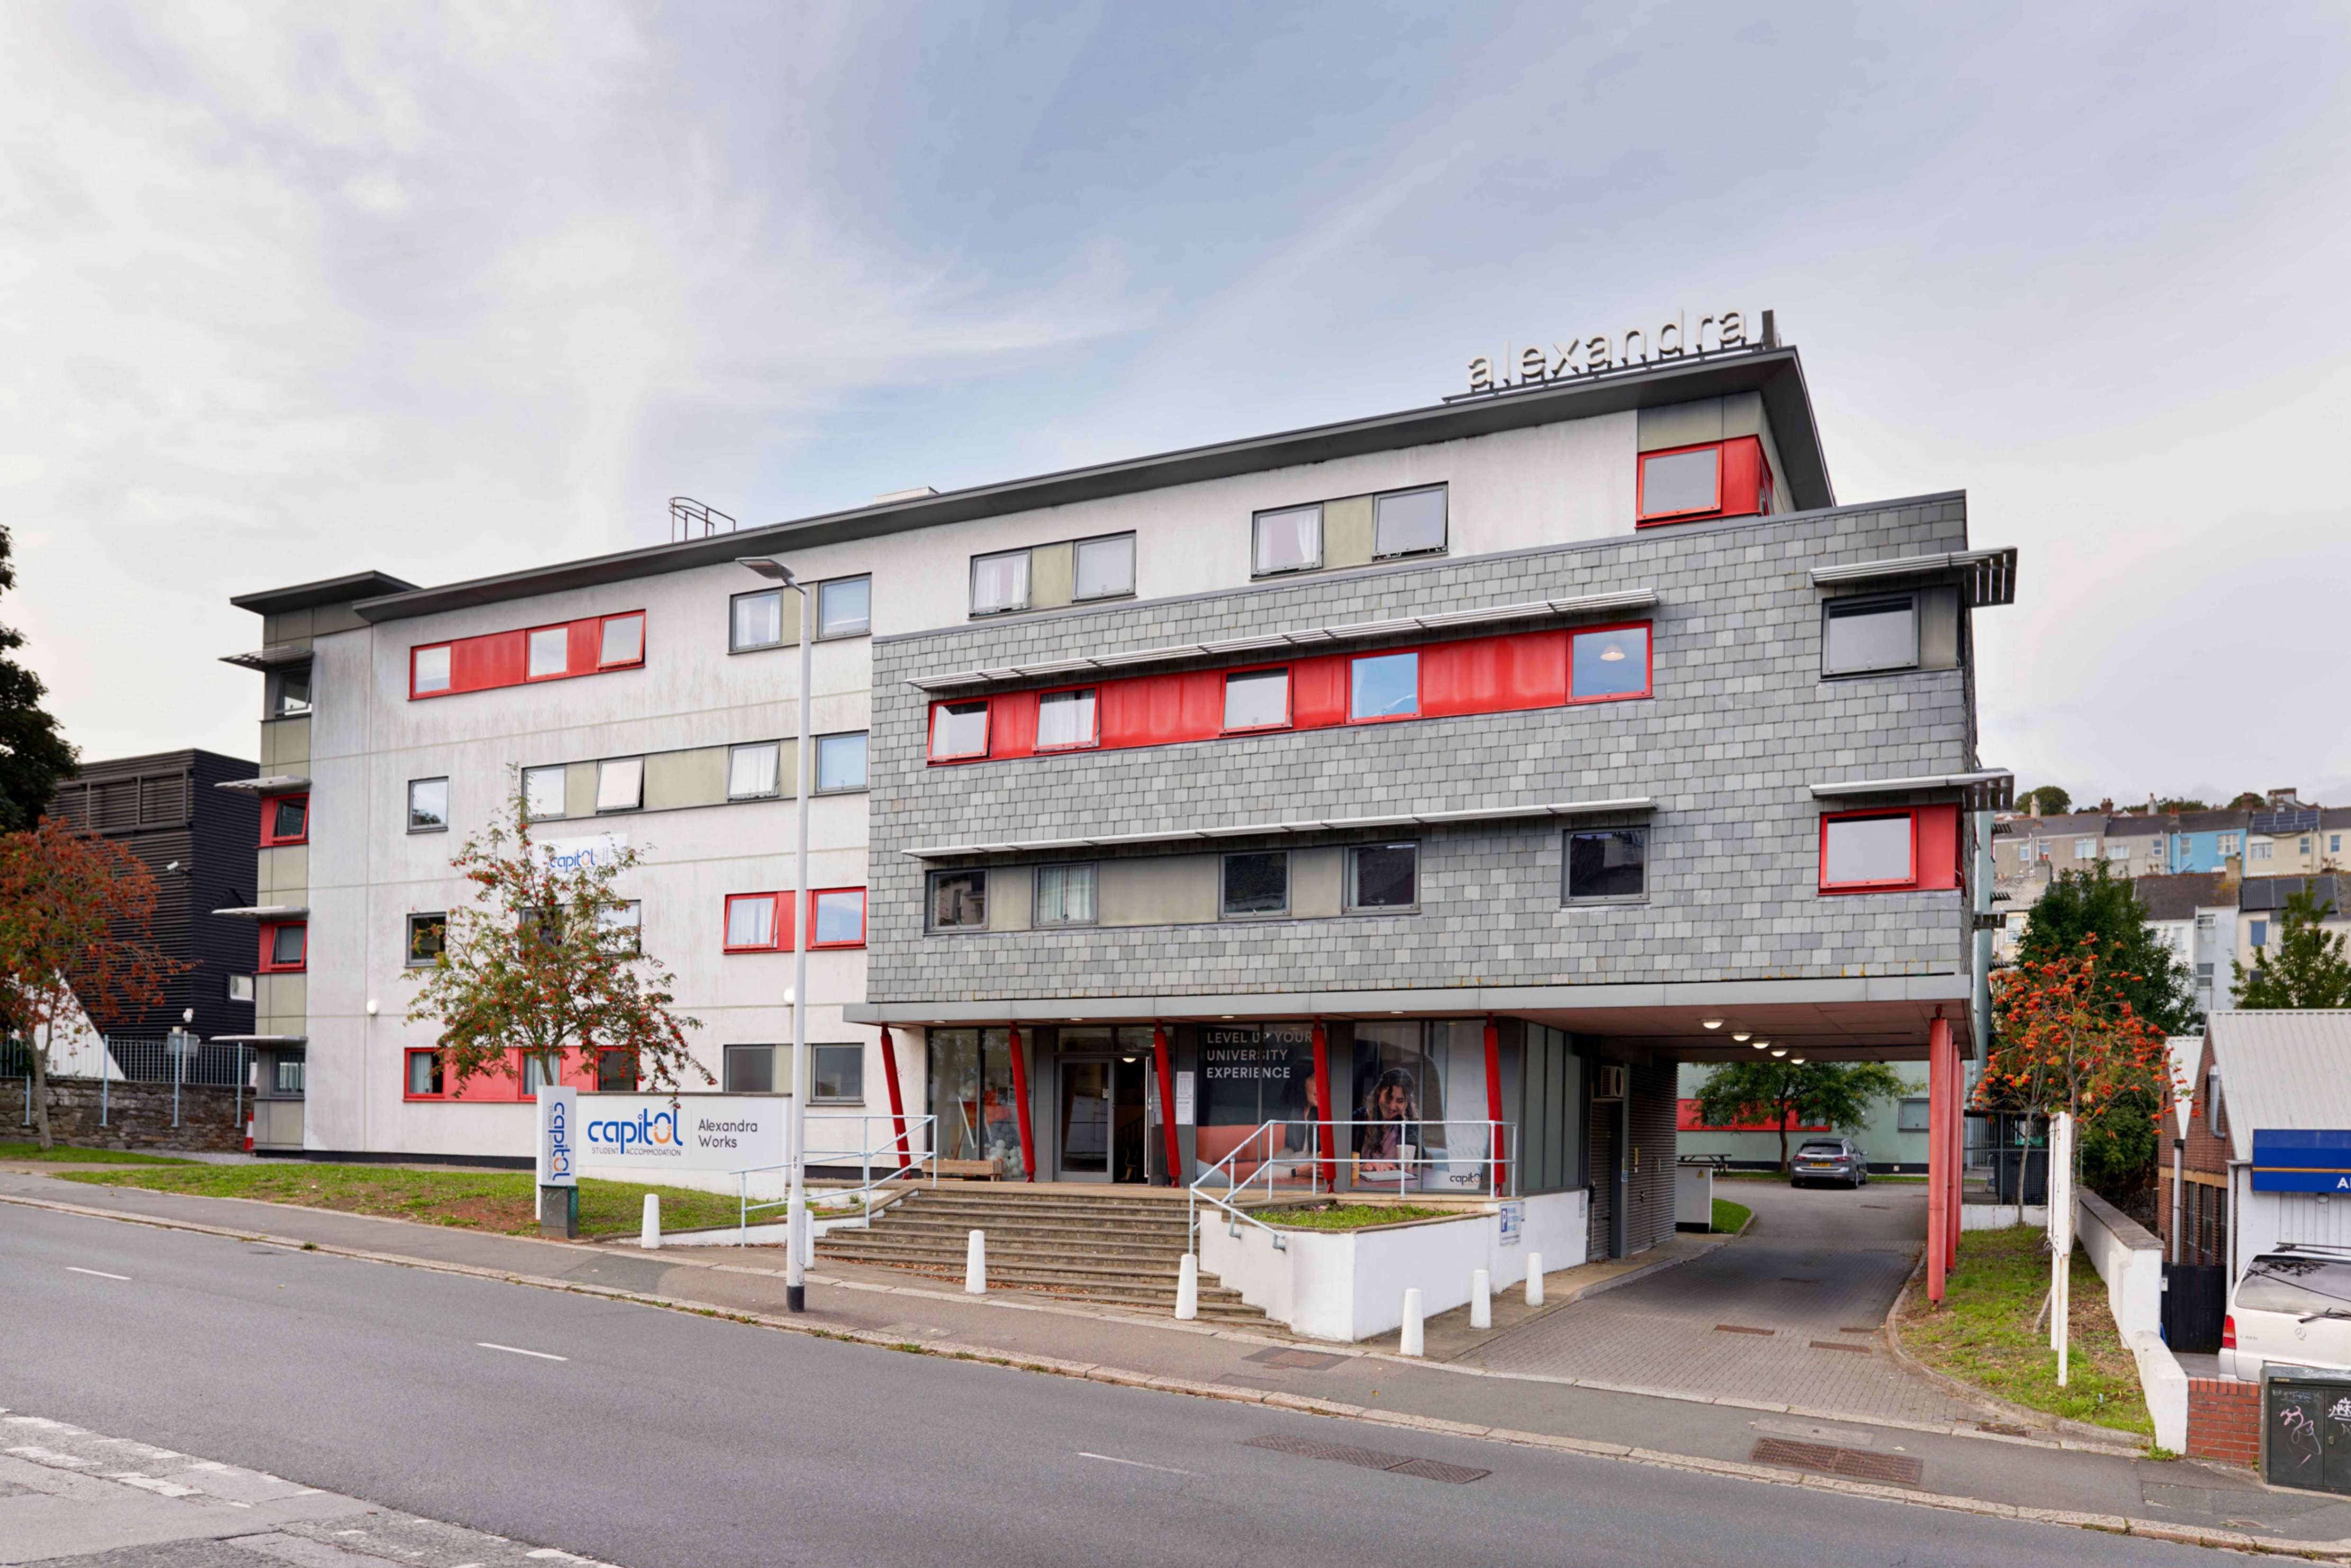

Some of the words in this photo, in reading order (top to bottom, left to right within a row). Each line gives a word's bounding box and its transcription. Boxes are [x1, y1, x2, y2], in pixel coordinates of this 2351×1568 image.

[1468, 308, 1747, 387] alexandra
[550, 847, 595, 873] capitol
[1207, 1032, 1247, 1044] LEVEL
[1274, 1031, 1313, 1043] YOUR
[1207, 1067, 1290, 1078] EXPERIENCE
[587, 1108, 683, 1154] capitol
[698, 1118, 758, 1132] Alexandra
[548, 1102, 571, 1181] capitol
[699, 1135, 737, 1148] Works
[2336, 1176, 2351, 1189] A
